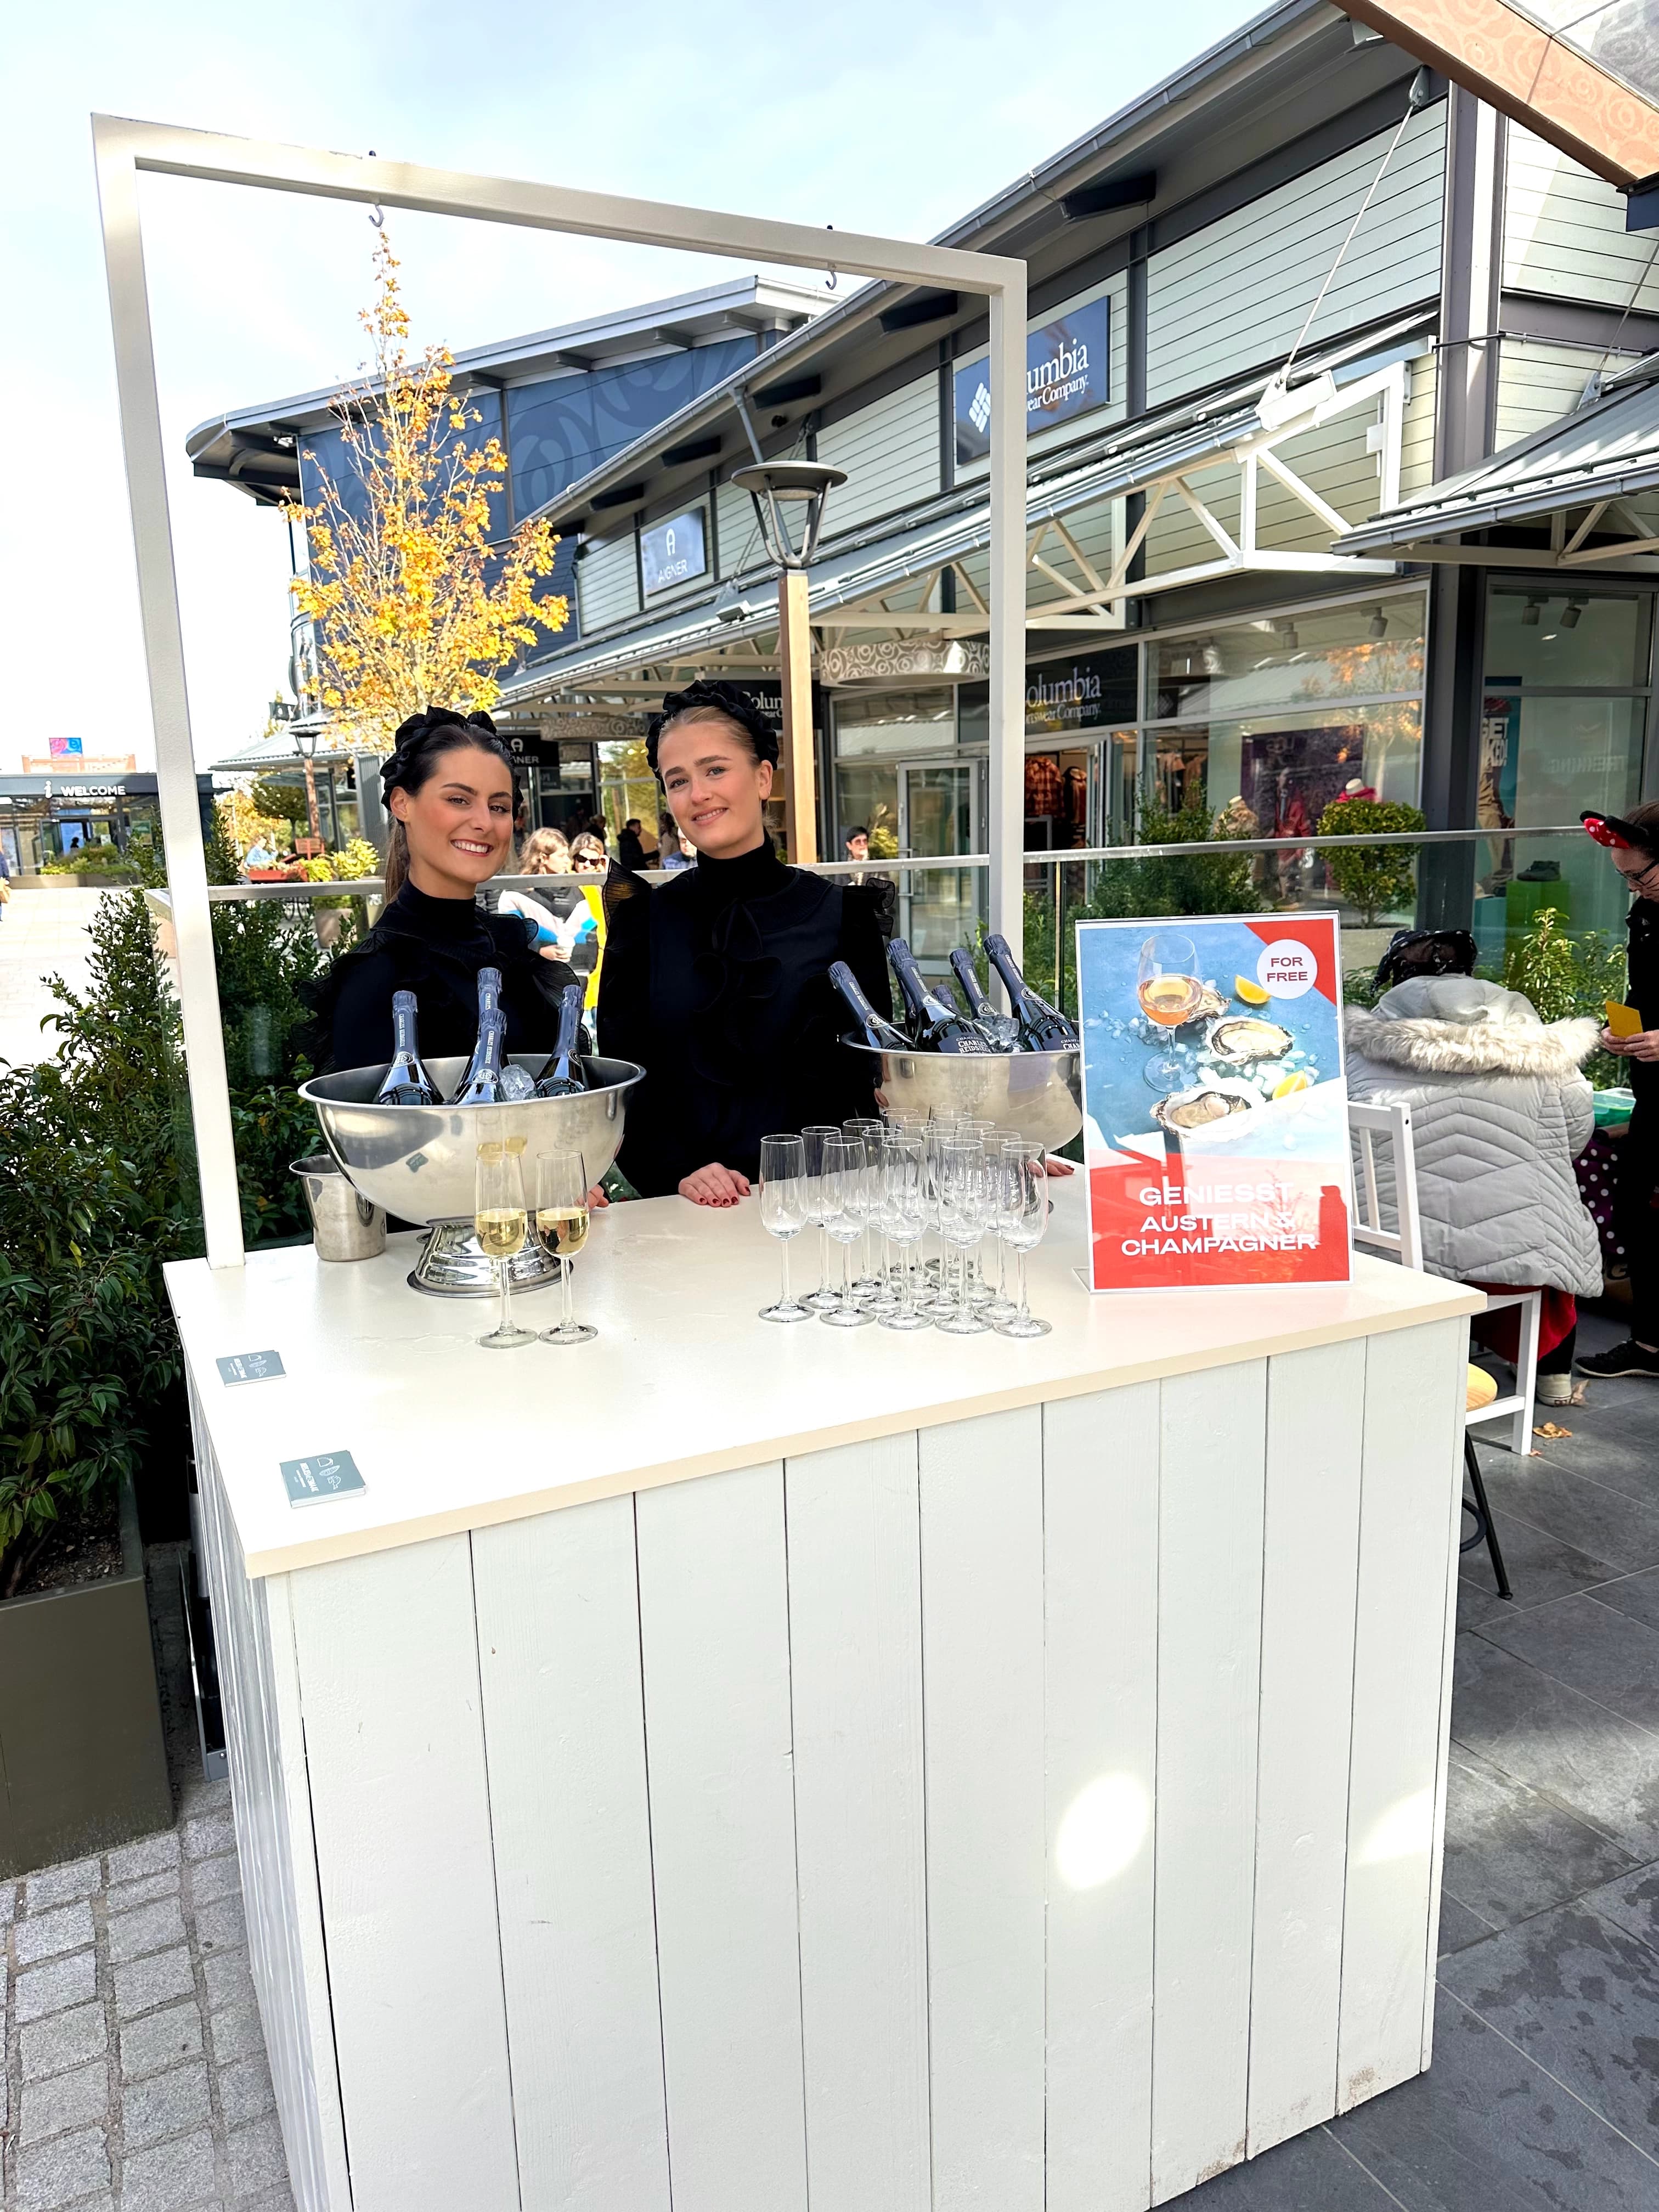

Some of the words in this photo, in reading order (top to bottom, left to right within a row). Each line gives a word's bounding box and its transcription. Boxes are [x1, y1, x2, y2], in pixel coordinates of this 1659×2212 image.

[1027, 338, 1089, 395] umbia
[658, 559, 688, 584] AIGNER
[1025, 667, 1102, 708] olumbia
[514, 755, 540, 764] NER
[60, 785, 126, 797] WELCOME
[1271, 957, 1303, 967] FOR
[1267, 972, 1308, 982] FREE
[1139, 1182, 1294, 1206] GENIESST
[1139, 1212, 1268, 1233] AUSTERN
[1121, 1234, 1316, 1257] CHAMPAGNER
